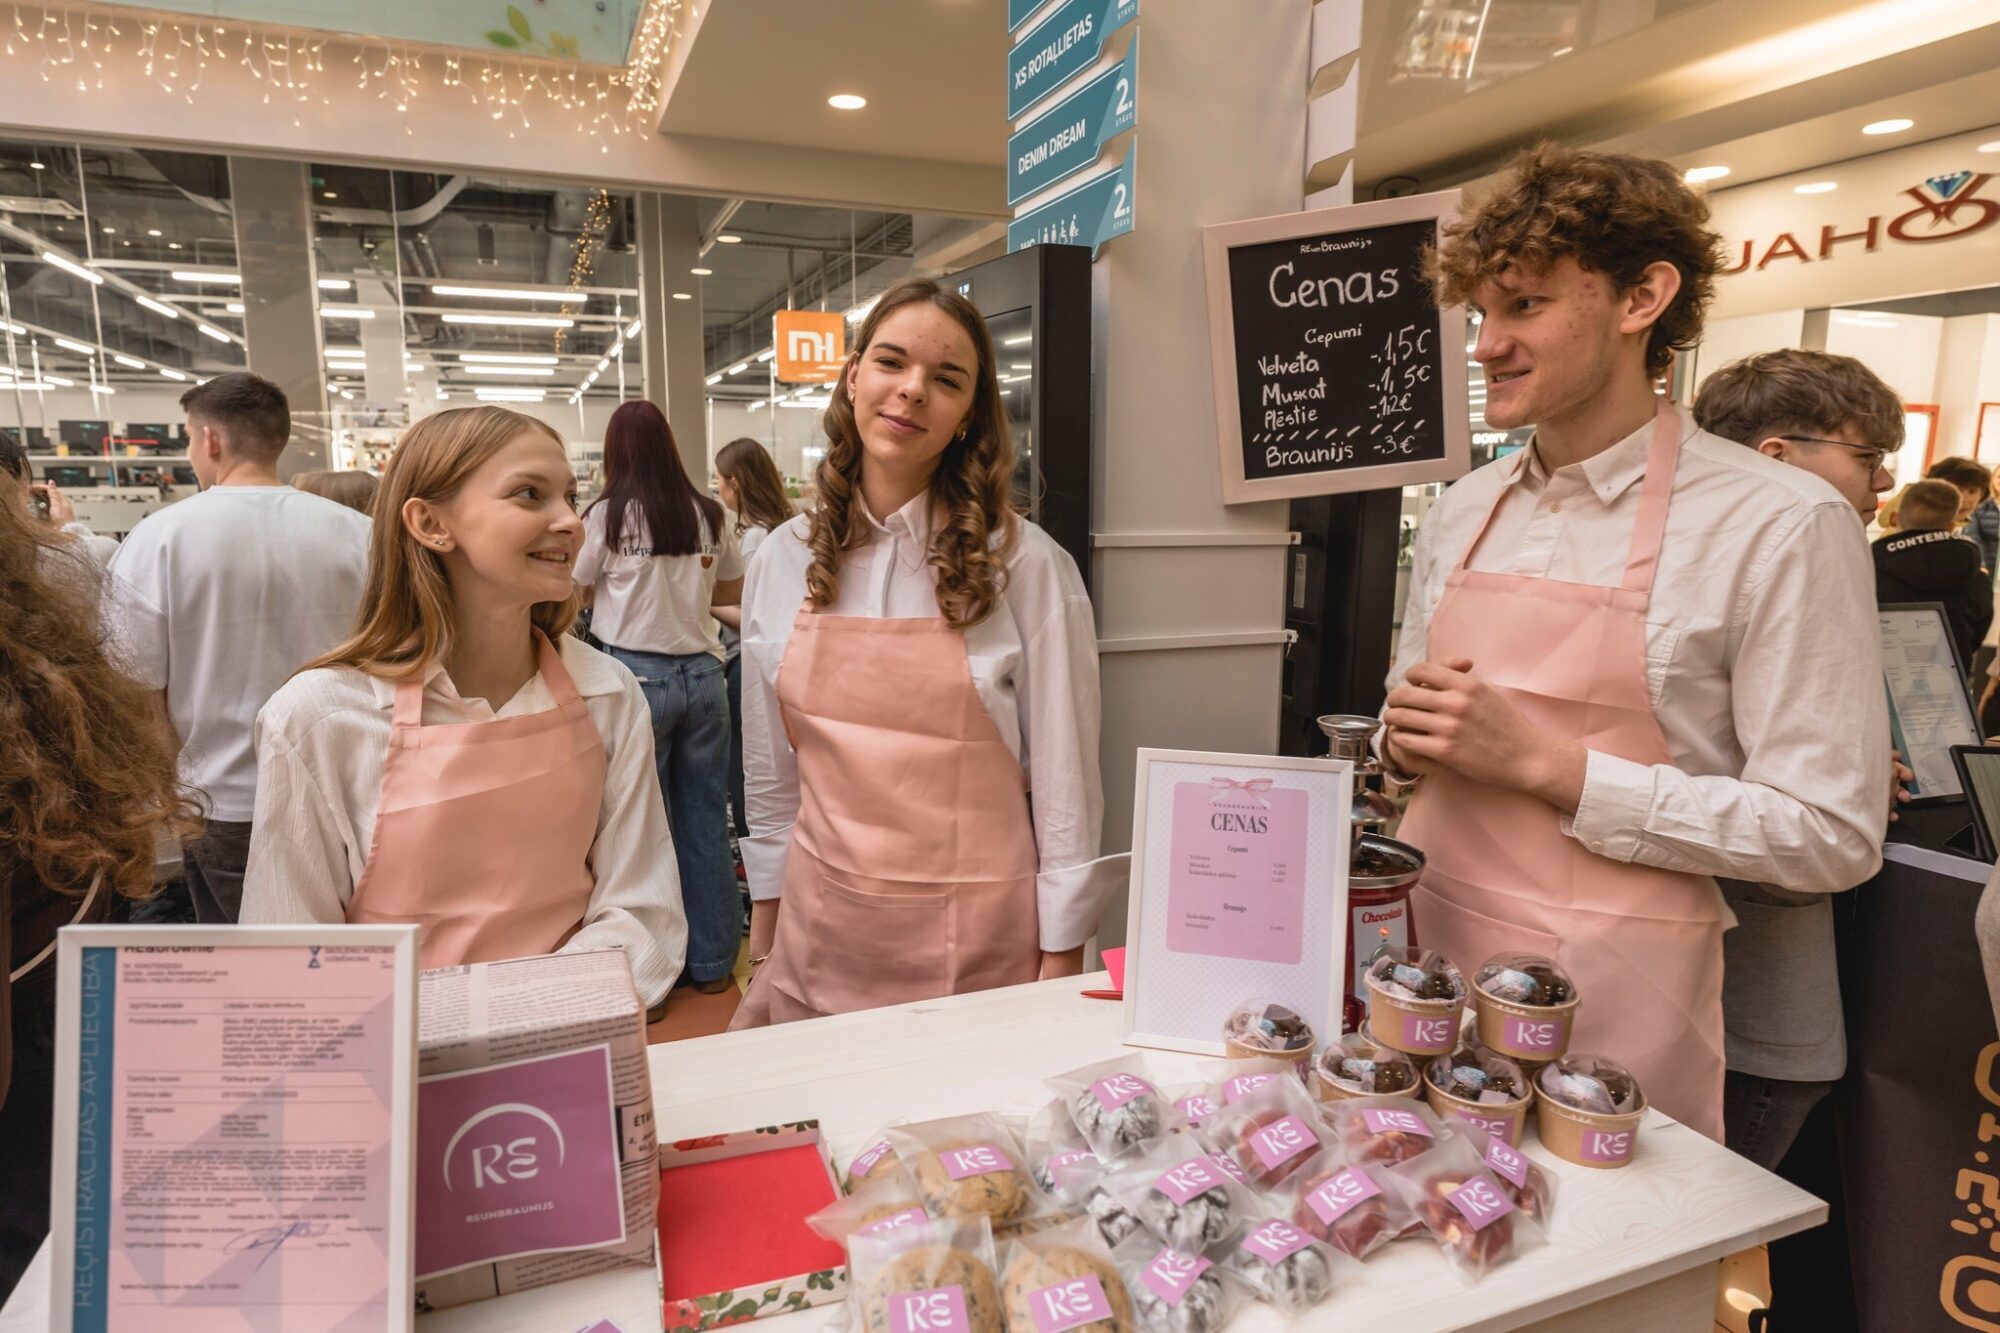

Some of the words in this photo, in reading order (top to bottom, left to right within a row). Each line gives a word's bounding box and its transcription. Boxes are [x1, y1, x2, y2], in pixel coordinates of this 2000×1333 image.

[1014, 66, 1027, 90] XS
[1028, 13, 1093, 75] ROTAĻLIETAS
[1115, 78, 1133, 116] 2.
[1018, 142, 1047, 175] DENIM
[1049, 119, 1086, 157] DREAM
[1113, 183, 1130, 219] 2.
[1268, 261, 1400, 308] Cenas
[1305, 323, 1363, 348] Cepumi
[1258, 351, 1320, 376] Velveta
[1262, 377, 1327, 406] Muskat
[1266, 441, 1354, 468] Braunijs
[1211, 812, 1268, 834] CENAS
[1414, 1020, 1451, 1042] RE
[1517, 1021, 1554, 1046] RE
[1101, 1073, 1143, 1099] RE
[1377, 1111, 1418, 1129] RE
[1261, 1121, 1303, 1156] RE
[1592, 1132, 1629, 1155] RE
[472, 1136, 539, 1189] RE
[954, 1147, 997, 1171] RE
[1166, 1162, 1211, 1193] RE
[1319, 1173, 1364, 1211] RE
[466, 1201, 555, 1224] REUNBRAUNIJS
[1459, 1181, 1500, 1216] RE
[1254, 1221, 1299, 1251] RE
[904, 1292, 952, 1331] RE
[1043, 1280, 1093, 1322] RE
